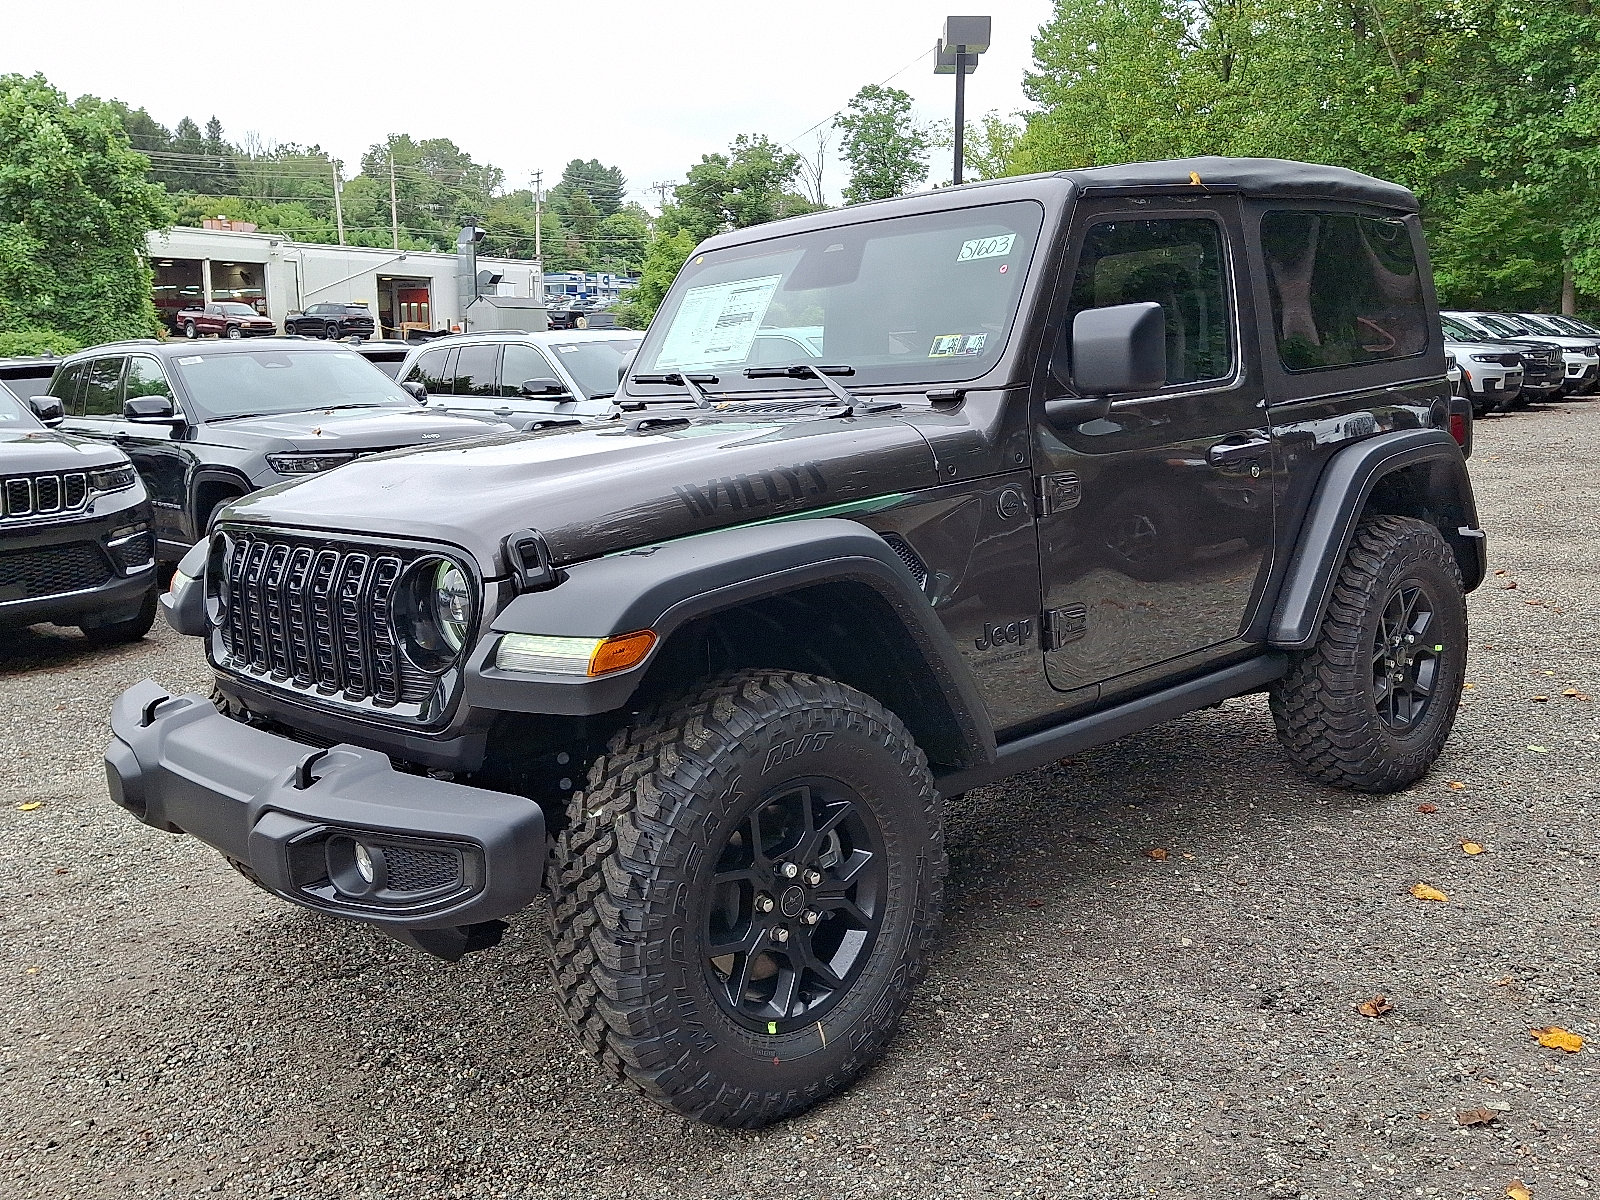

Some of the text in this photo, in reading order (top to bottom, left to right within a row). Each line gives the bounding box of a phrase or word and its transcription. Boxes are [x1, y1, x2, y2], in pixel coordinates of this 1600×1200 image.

[672, 459, 828, 518] WILLYS
[975, 619, 1033, 651] Jeep
[761, 731, 834, 775] M/T
